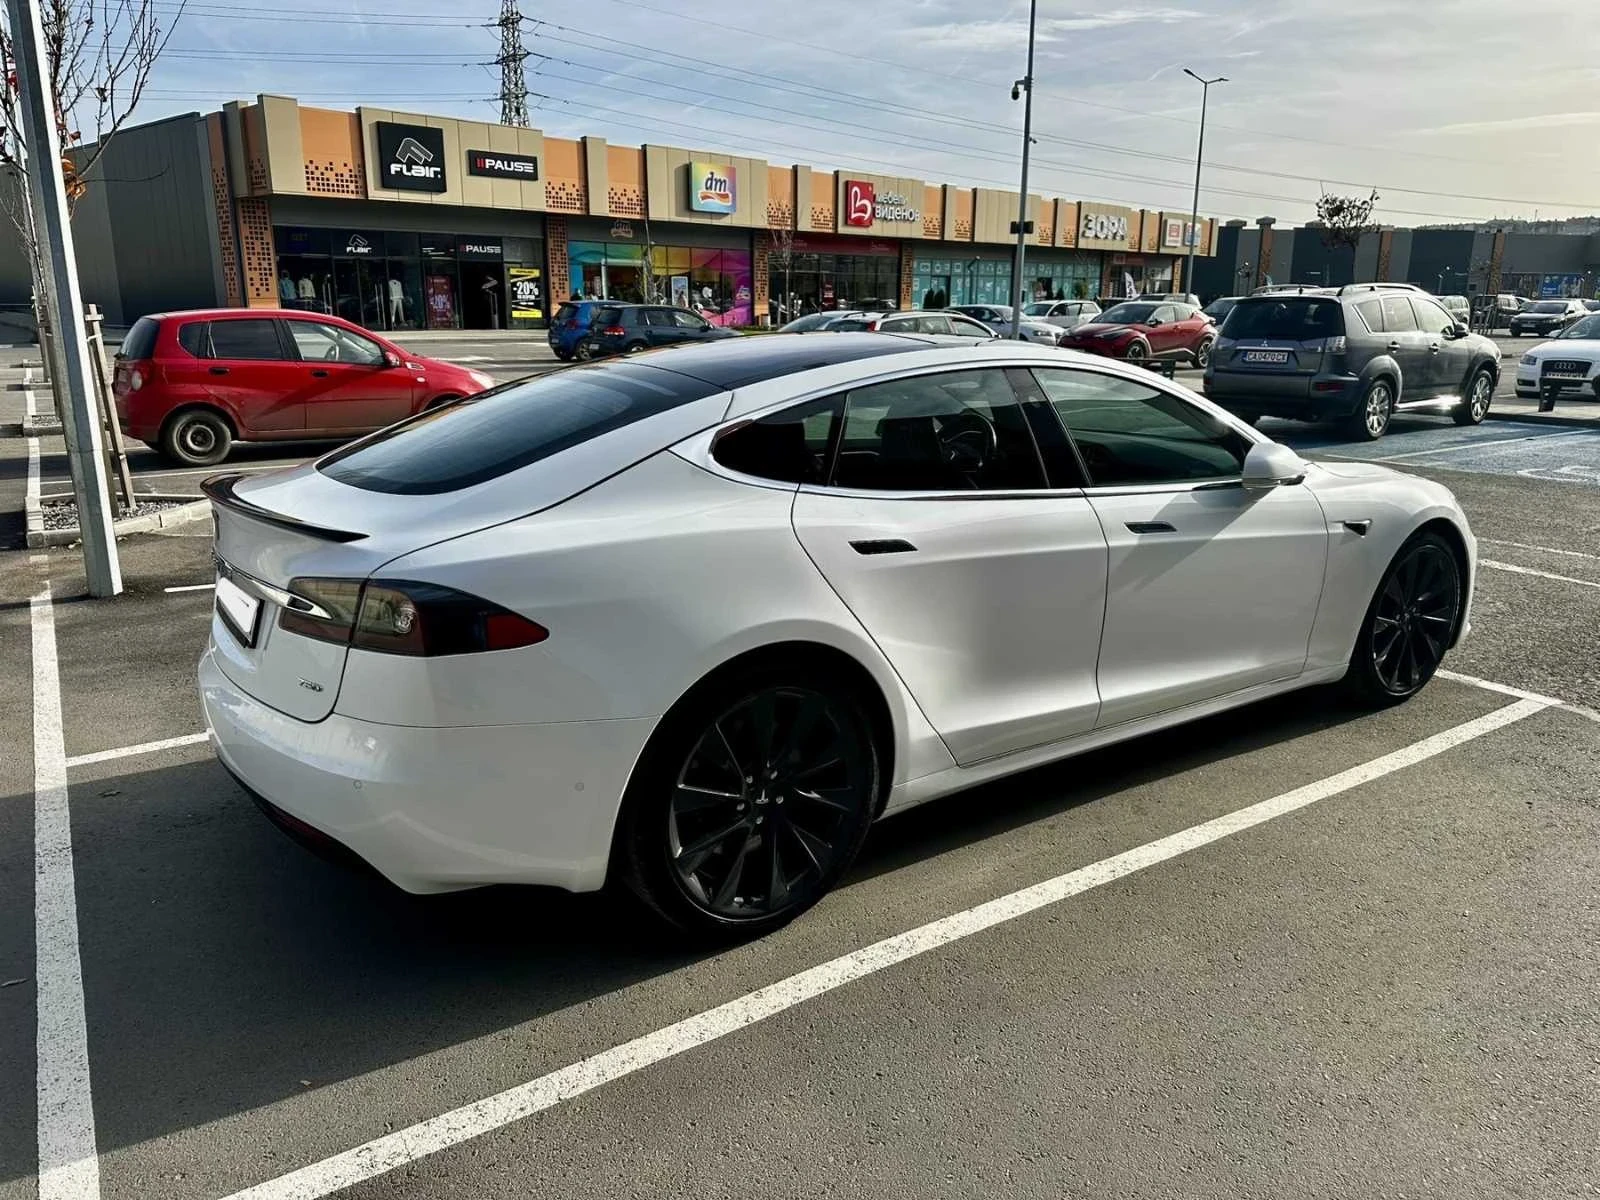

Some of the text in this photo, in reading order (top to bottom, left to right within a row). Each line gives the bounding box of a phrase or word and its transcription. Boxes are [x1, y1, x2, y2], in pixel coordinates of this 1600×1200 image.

[485, 158, 534, 173] PAUSE
[705, 171, 727, 193] dm
[1082, 213, 1127, 240] ЗОРА
[466, 245, 501, 254] PAUSE
[513, 281, 539, 295] -20%
